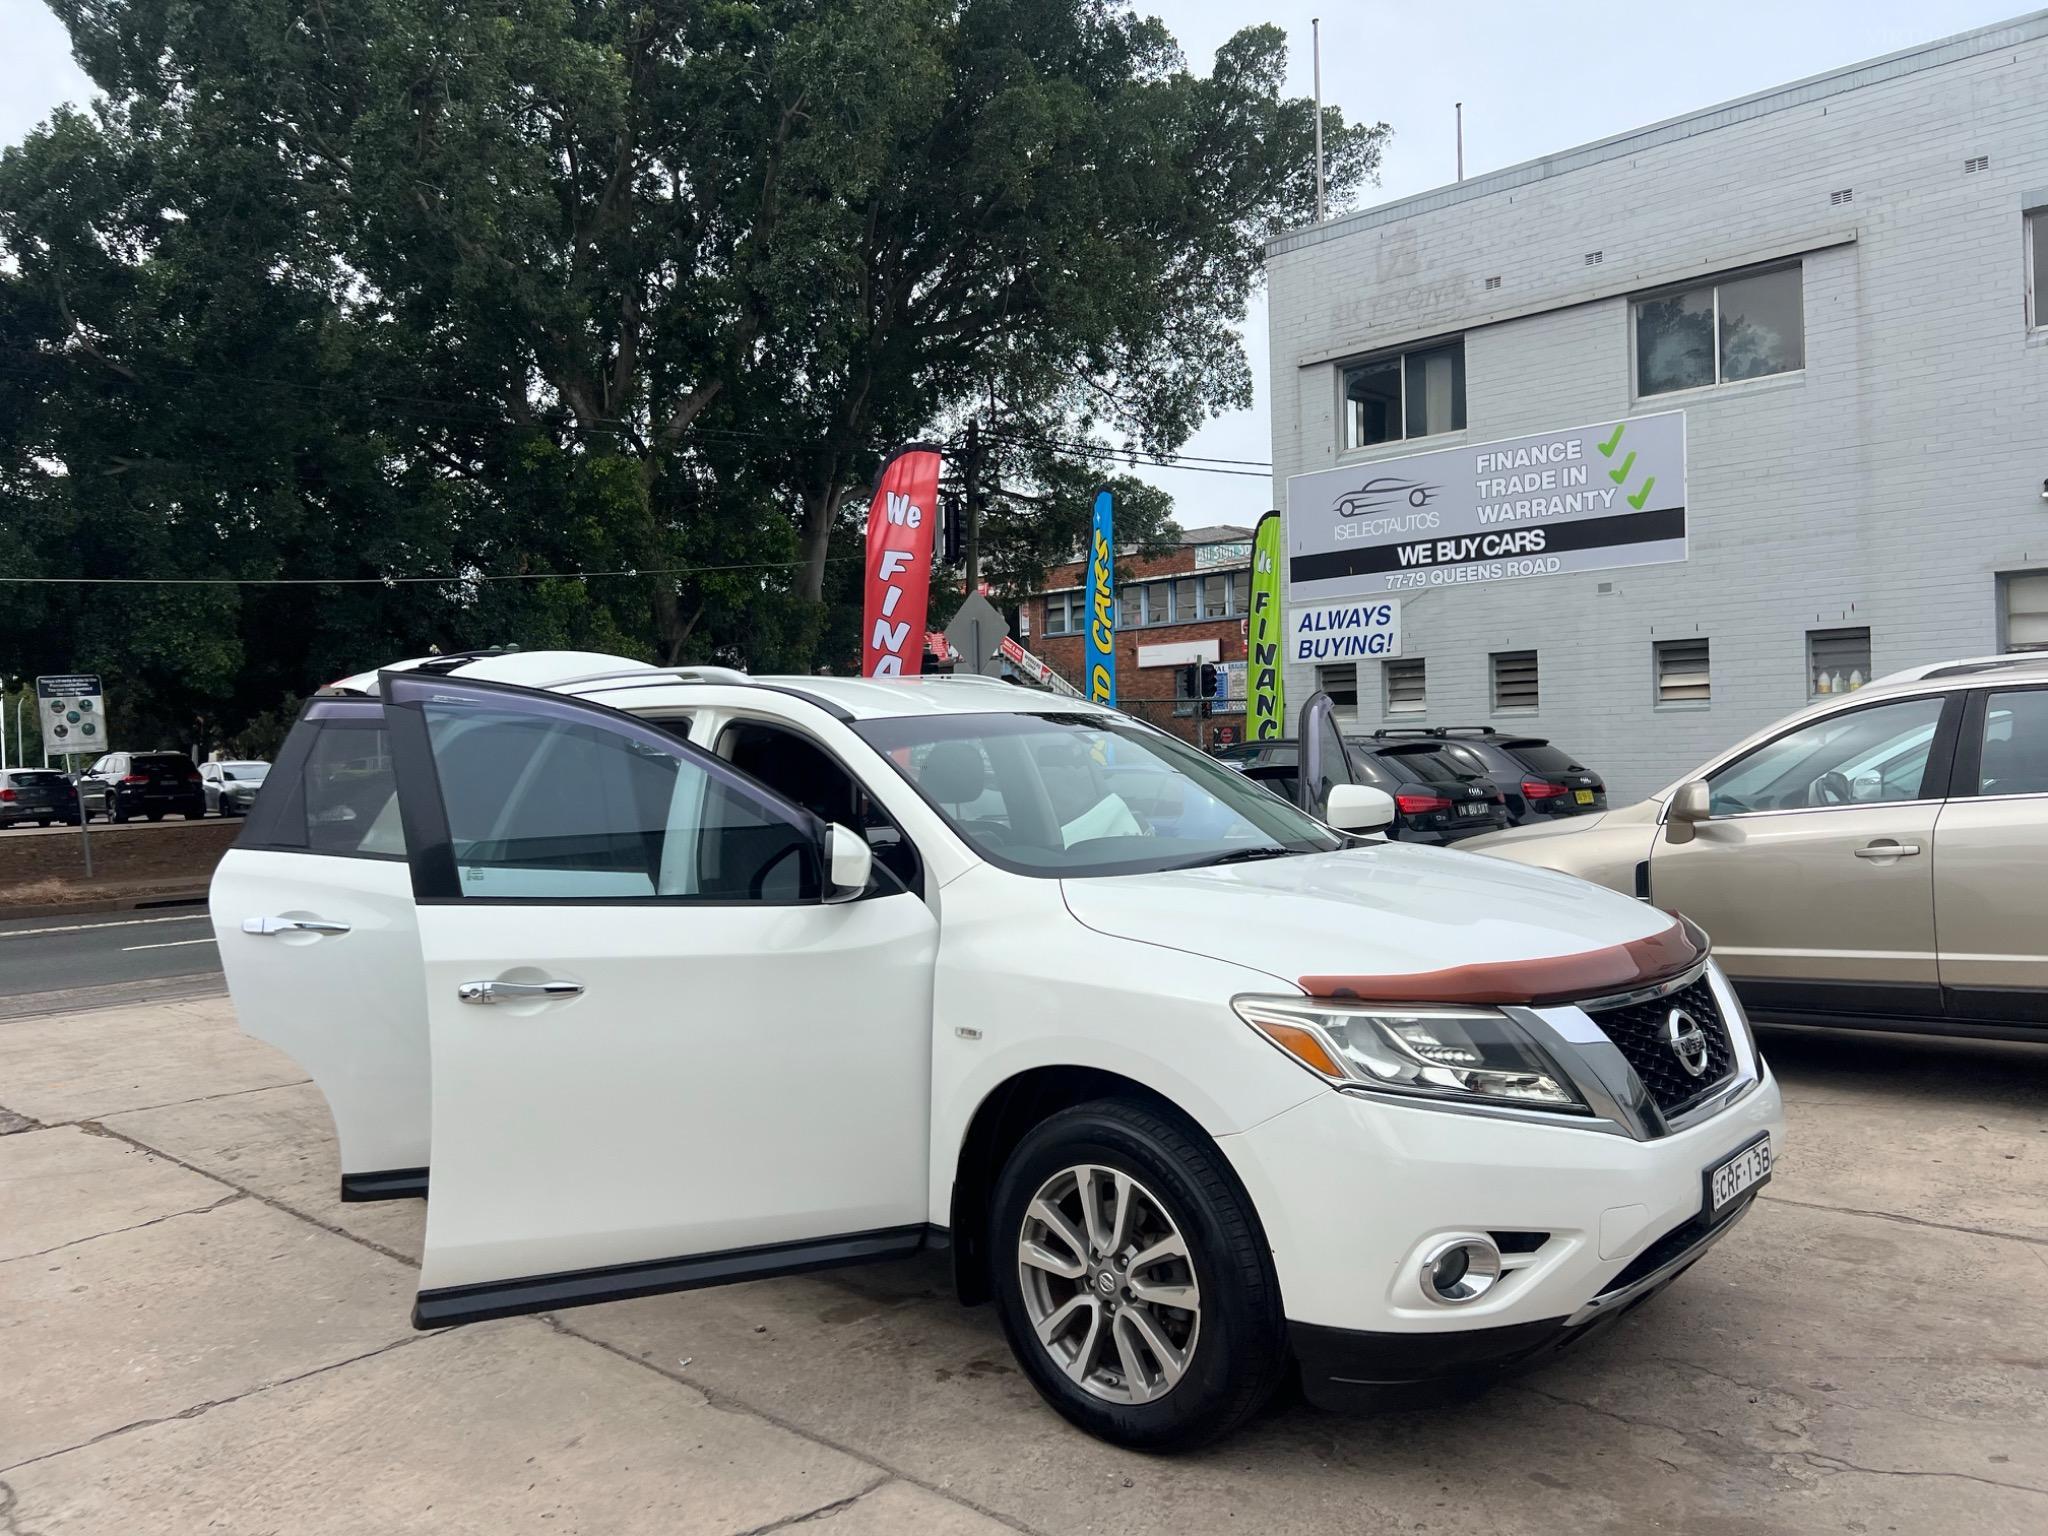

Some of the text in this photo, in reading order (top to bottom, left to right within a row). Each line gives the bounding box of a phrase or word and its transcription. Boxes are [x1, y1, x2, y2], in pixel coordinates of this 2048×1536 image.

[1476, 440, 1583, 475] FINANCE
[1476, 465, 1588, 499] TRADE IN
[886, 491, 922, 529] We
[1476, 488, 1618, 524] WARRANTY
[1334, 512, 1440, 541] ISELECTAUTOS
[1397, 529, 1546, 566] WE BUY CARS
[1385, 556, 1561, 590] 77-79 QUEENS ROAD
[1093, 527, 1113, 656] CARS
[1298, 604, 1392, 633] ALWAYS
[1298, 632, 1394, 660] BUYING!
